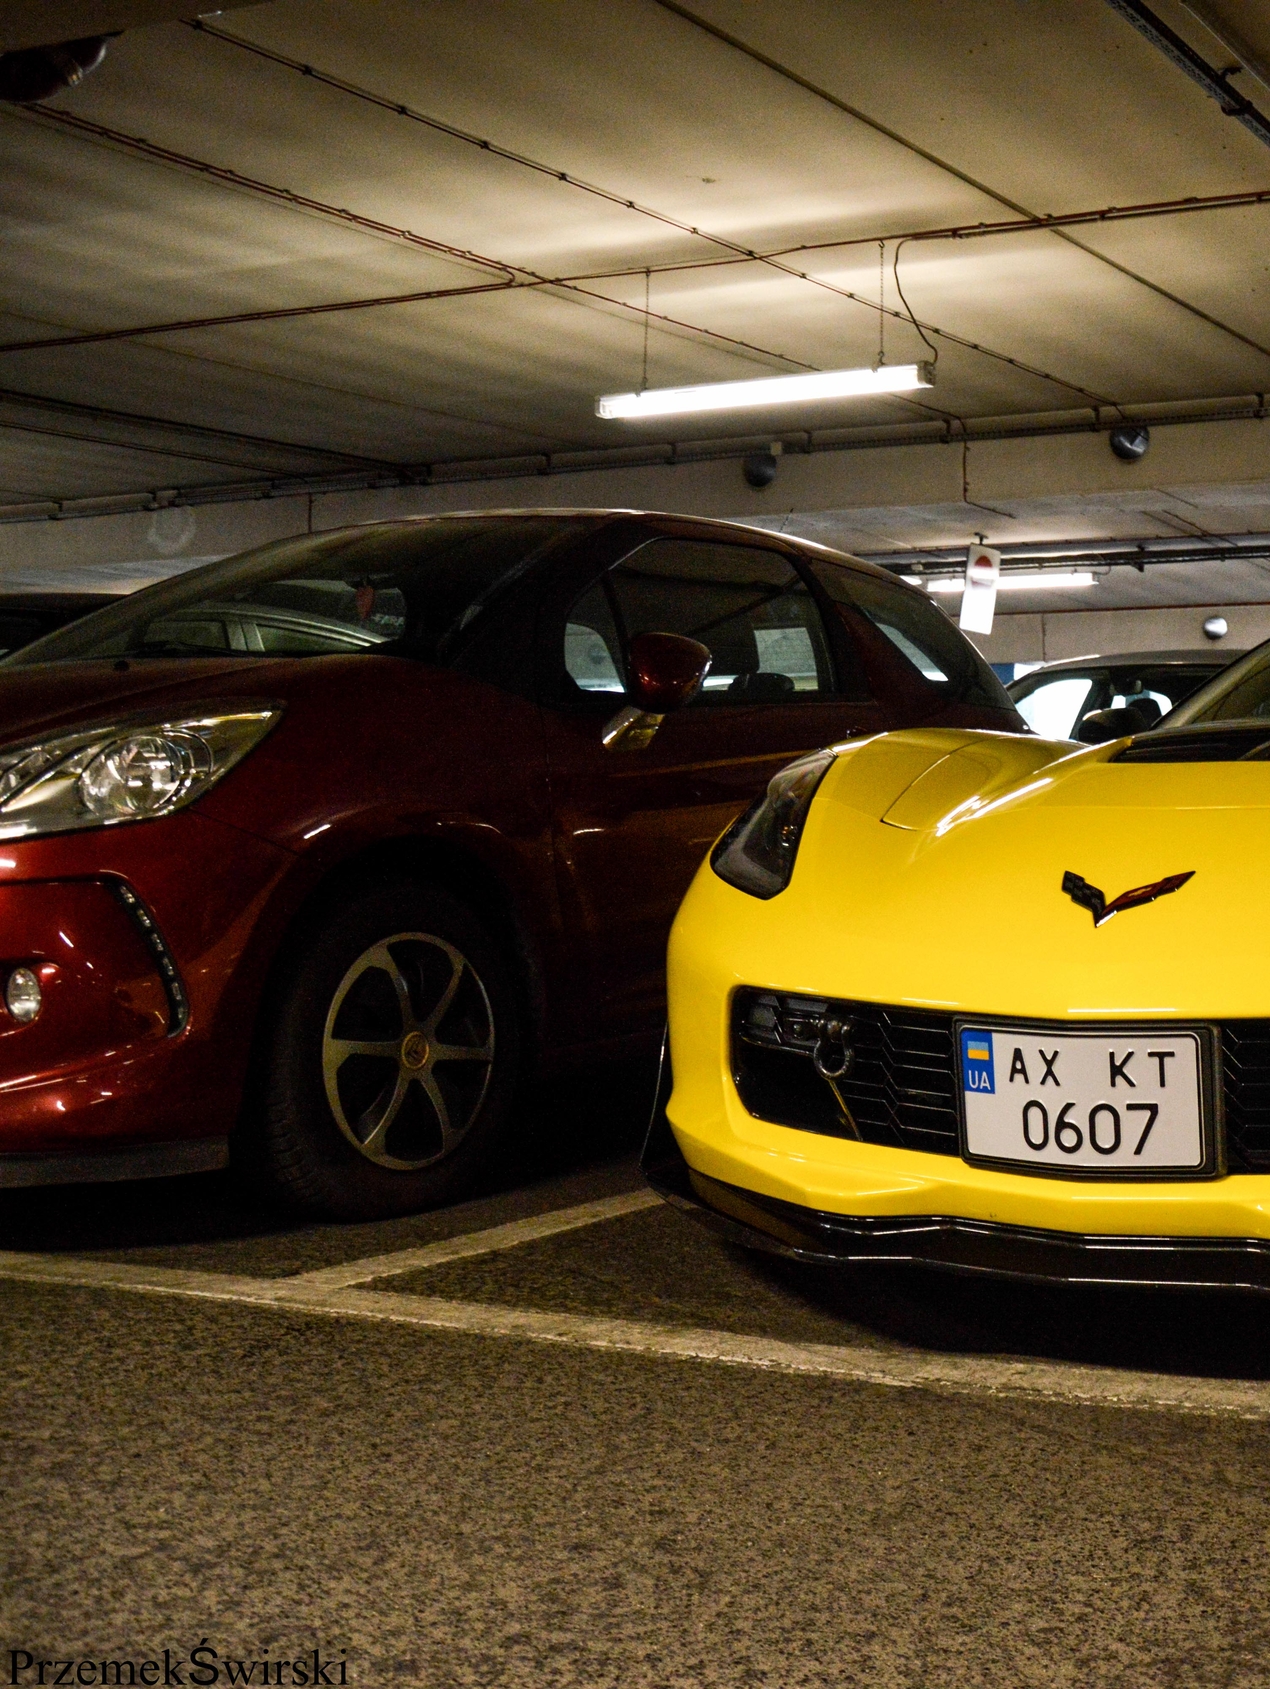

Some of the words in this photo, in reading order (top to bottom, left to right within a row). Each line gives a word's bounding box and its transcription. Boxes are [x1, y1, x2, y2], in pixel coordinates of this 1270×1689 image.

[967, 1070, 991, 1090] UA
[1009, 1047, 1061, 1087] AX
[1108, 1049, 1175, 1088] KT
[1022, 1099, 1159, 1156] 0607
